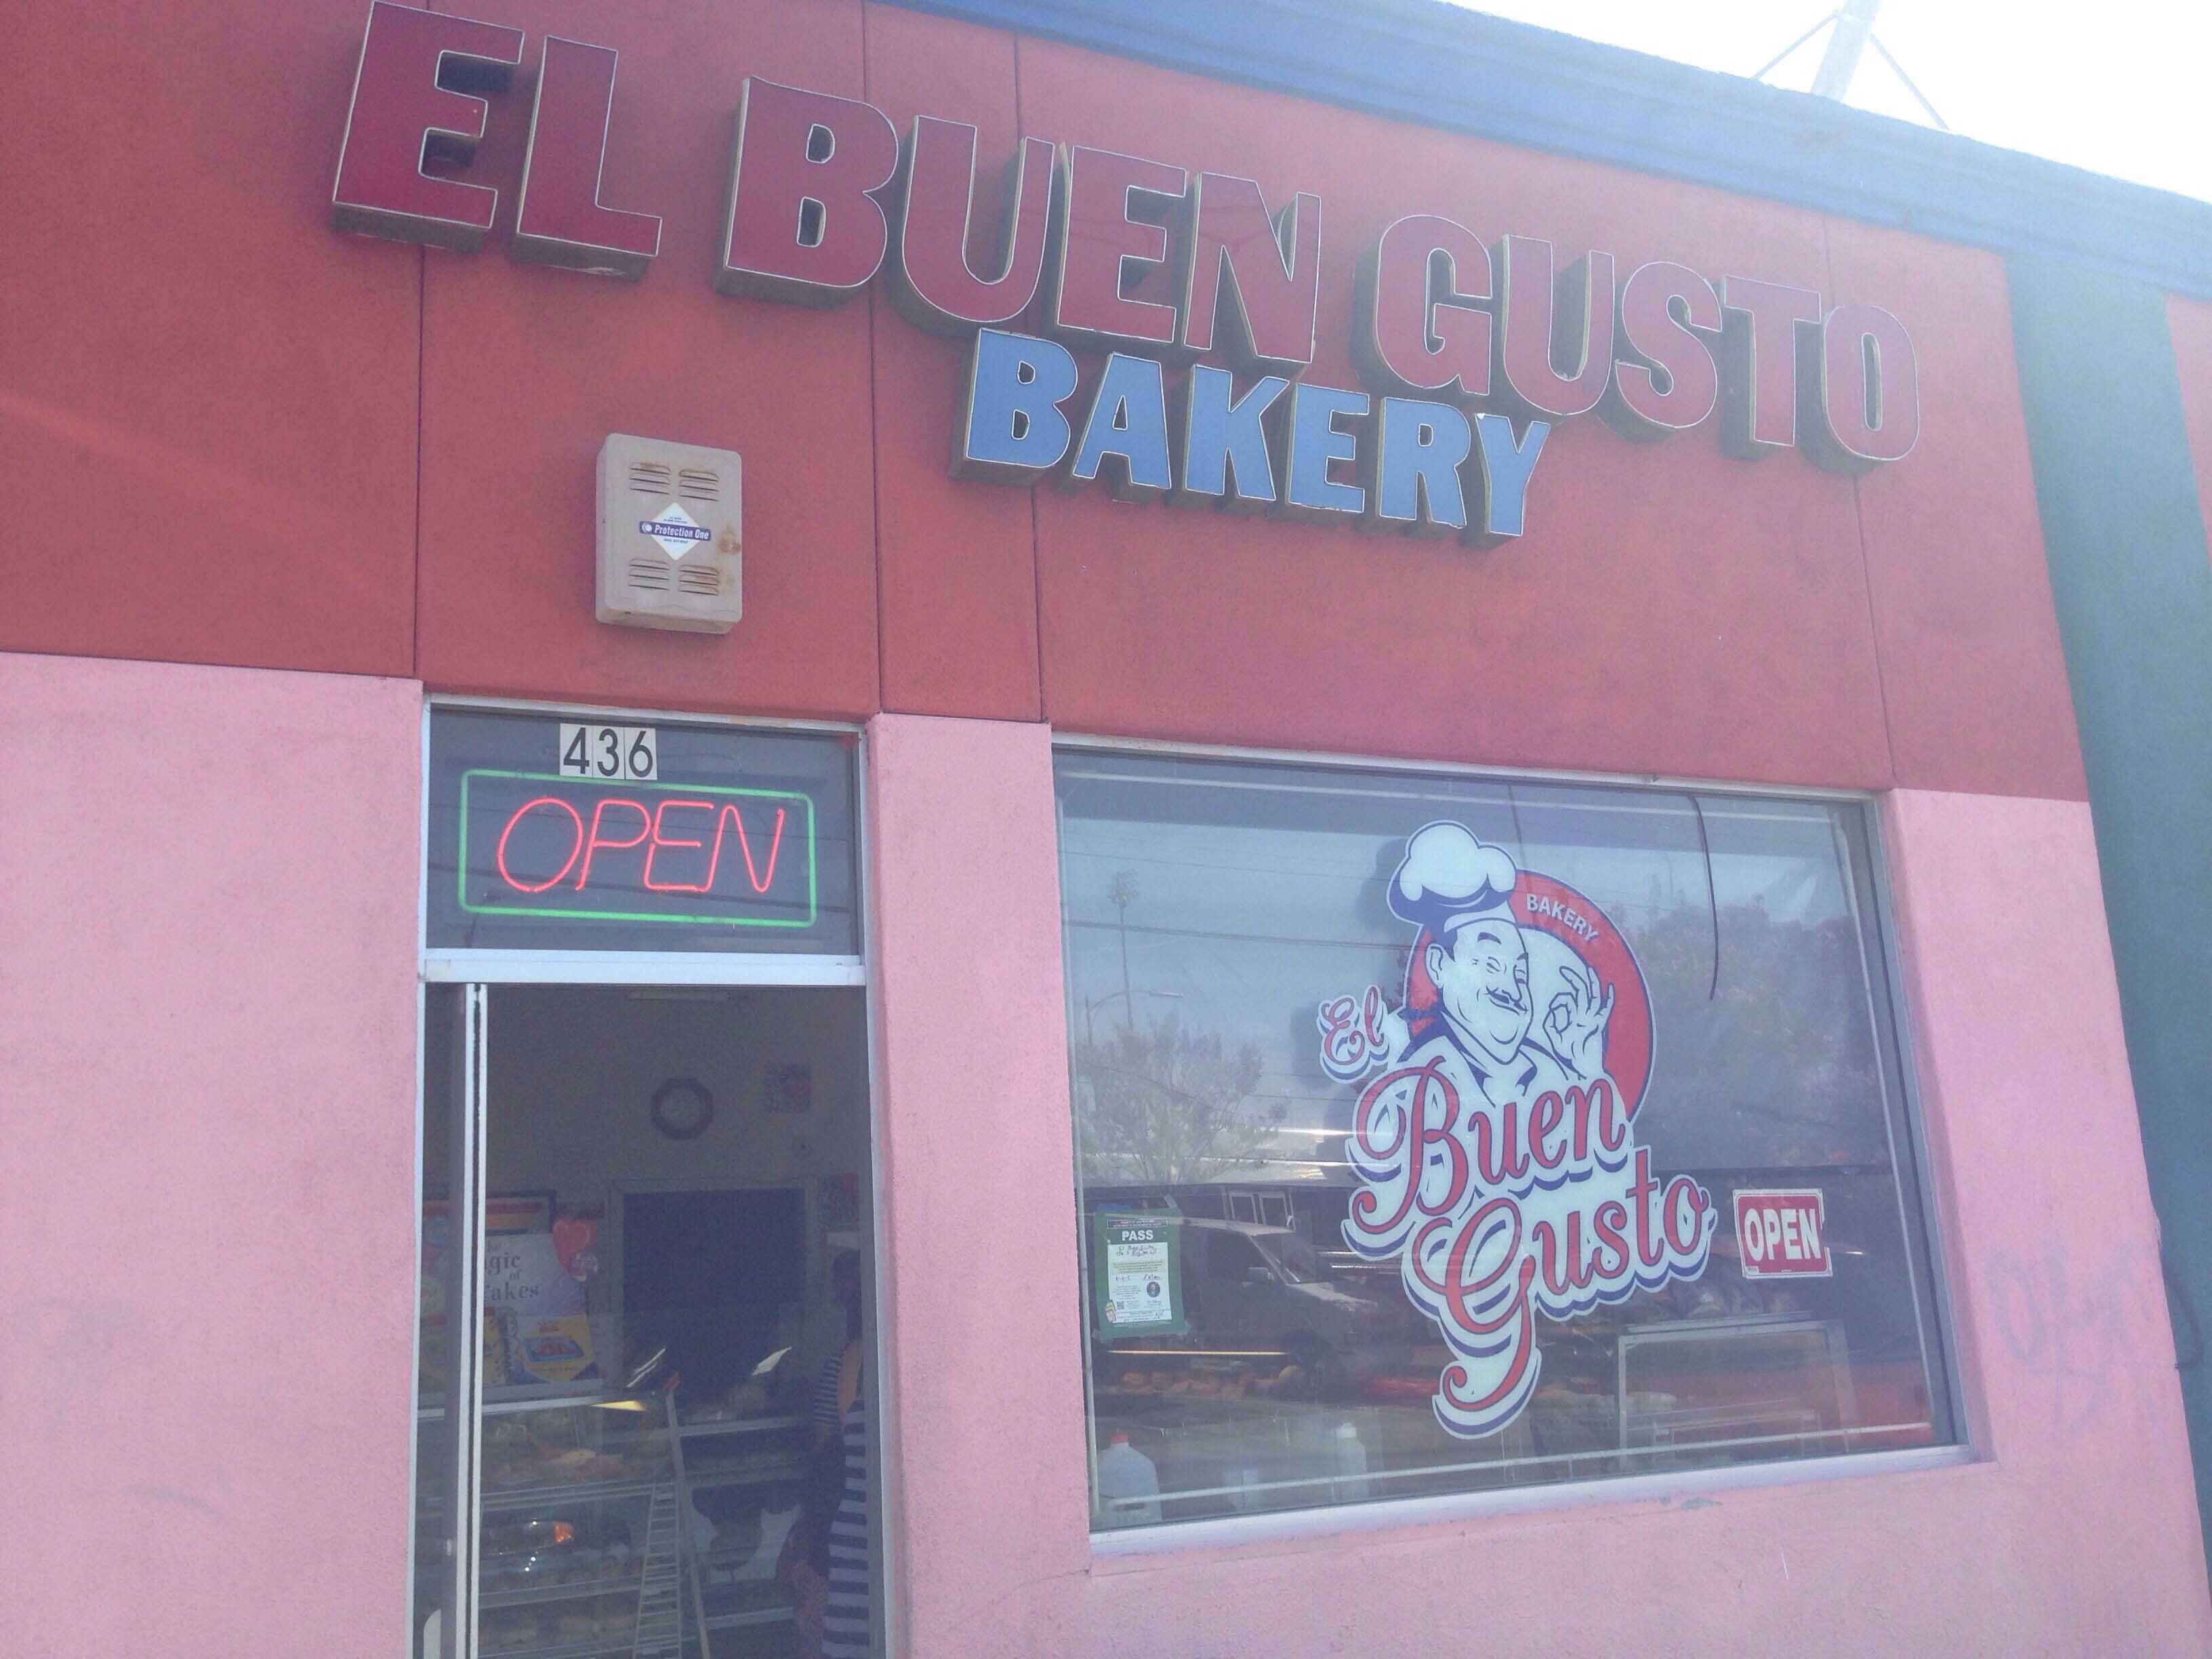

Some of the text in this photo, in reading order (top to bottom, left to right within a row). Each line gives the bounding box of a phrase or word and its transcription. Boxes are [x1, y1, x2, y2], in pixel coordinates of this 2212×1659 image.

[332, 0, 1921, 462] EL BUEN GUSTO
[965, 327, 1551, 537] BAKERY
[654, 524, 710, 539] Protection One
[562, 726, 654, 779] 436
[496, 796, 785, 893] OPEN
[1526, 893, 1600, 941] BAKERY
[1322, 986, 1385, 1066] El
[1352, 1054, 1626, 1233] Buen
[1122, 1229, 1154, 1242] PASS
[1744, 1208, 1822, 1261] OPEN
[1412, 1147, 1710, 1412] Gusto
